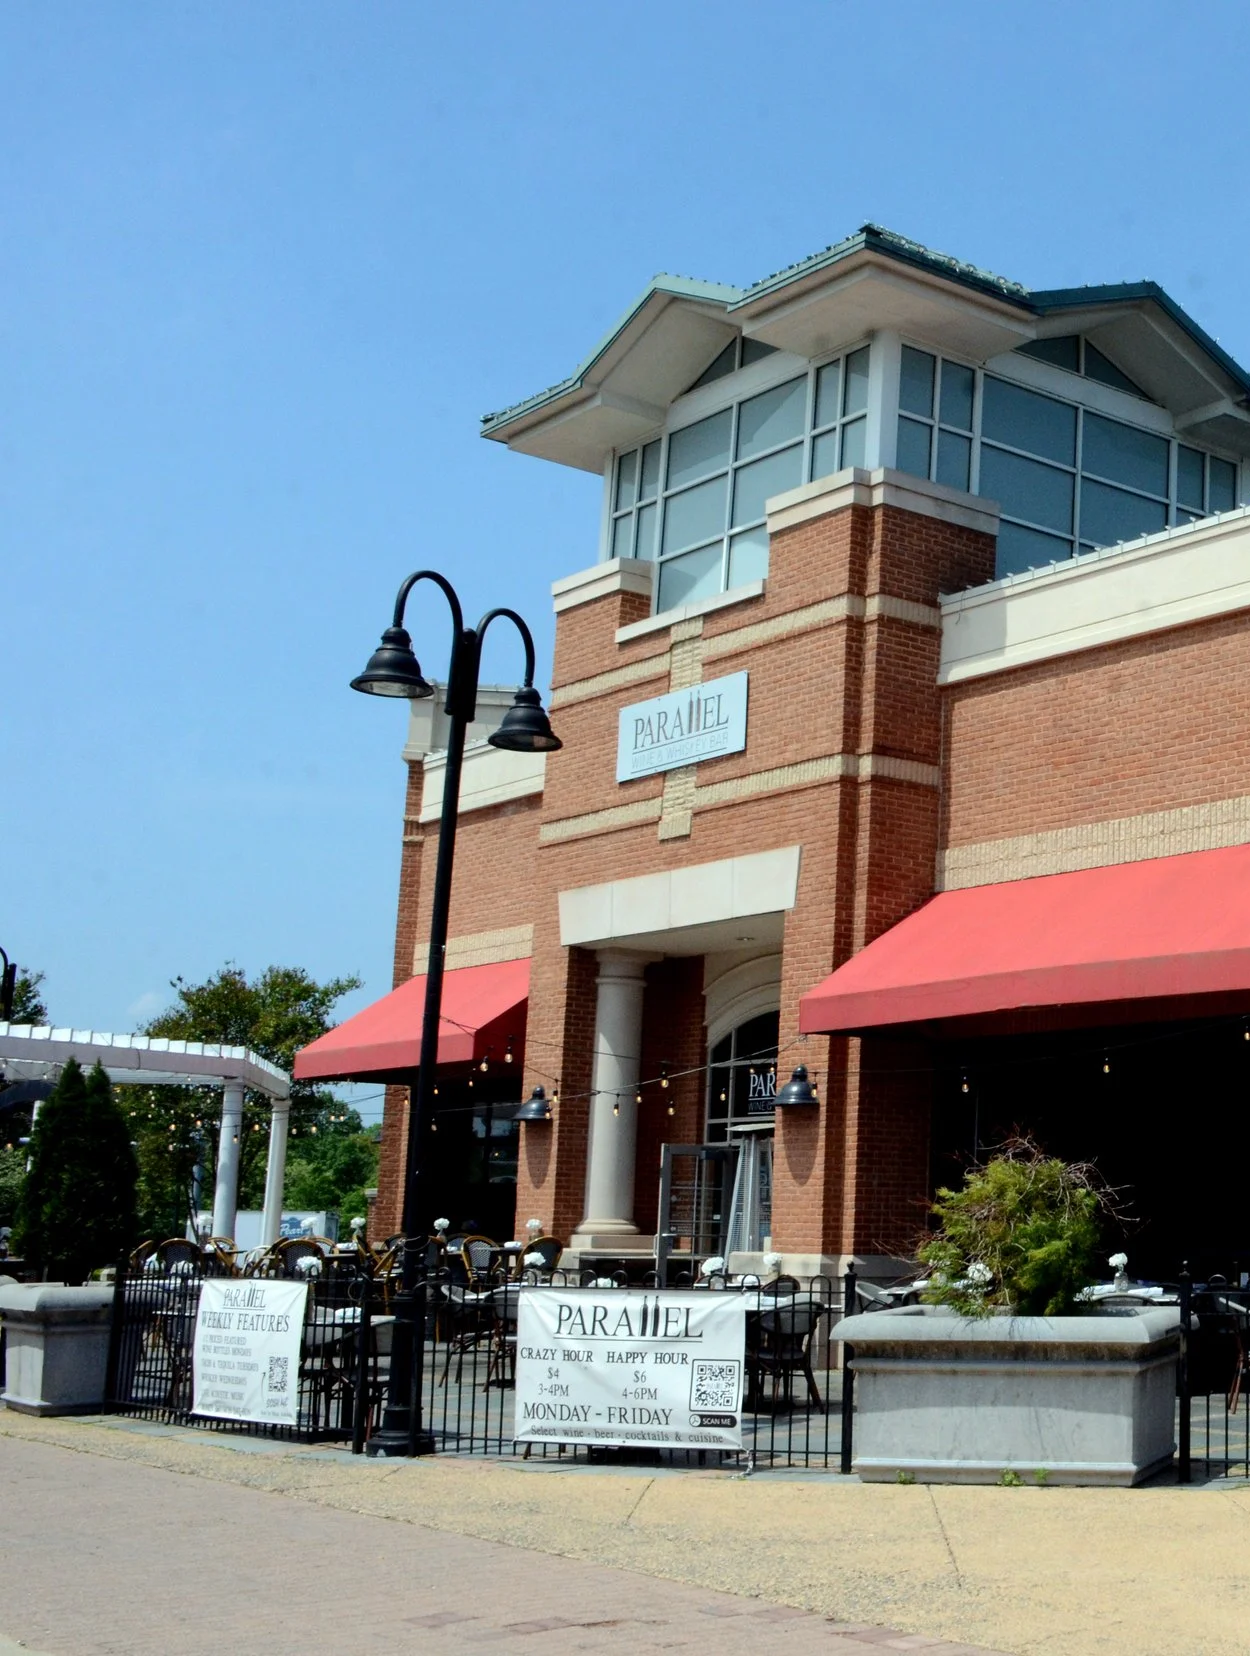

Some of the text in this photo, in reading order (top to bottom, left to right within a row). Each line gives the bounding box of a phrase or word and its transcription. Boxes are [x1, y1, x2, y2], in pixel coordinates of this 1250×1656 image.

[201, 1311, 290, 1332] WEEKLY FEATURES
[520, 1347, 594, 1362] CRAZY HOUR
[607, 1351, 689, 1365] HAPPY HOUR
[547, 1367, 560, 1380] $4
[633, 1370, 647, 1383] $6
[538, 1383, 569, 1397] 3-4PM
[622, 1387, 658, 1400] 4-6PM
[523, 1402, 591, 1422] MONDAY
[607, 1406, 673, 1426] FRIDAY
[702, 1417, 732, 1425] SCAN ME
[531, 1426, 557, 1437] Select
[562, 1428, 584, 1438] wine
[595, 1430, 614, 1439] beer
[625, 1430, 669, 1442] cocktails
[689, 1433, 724, 1443] cuisine
